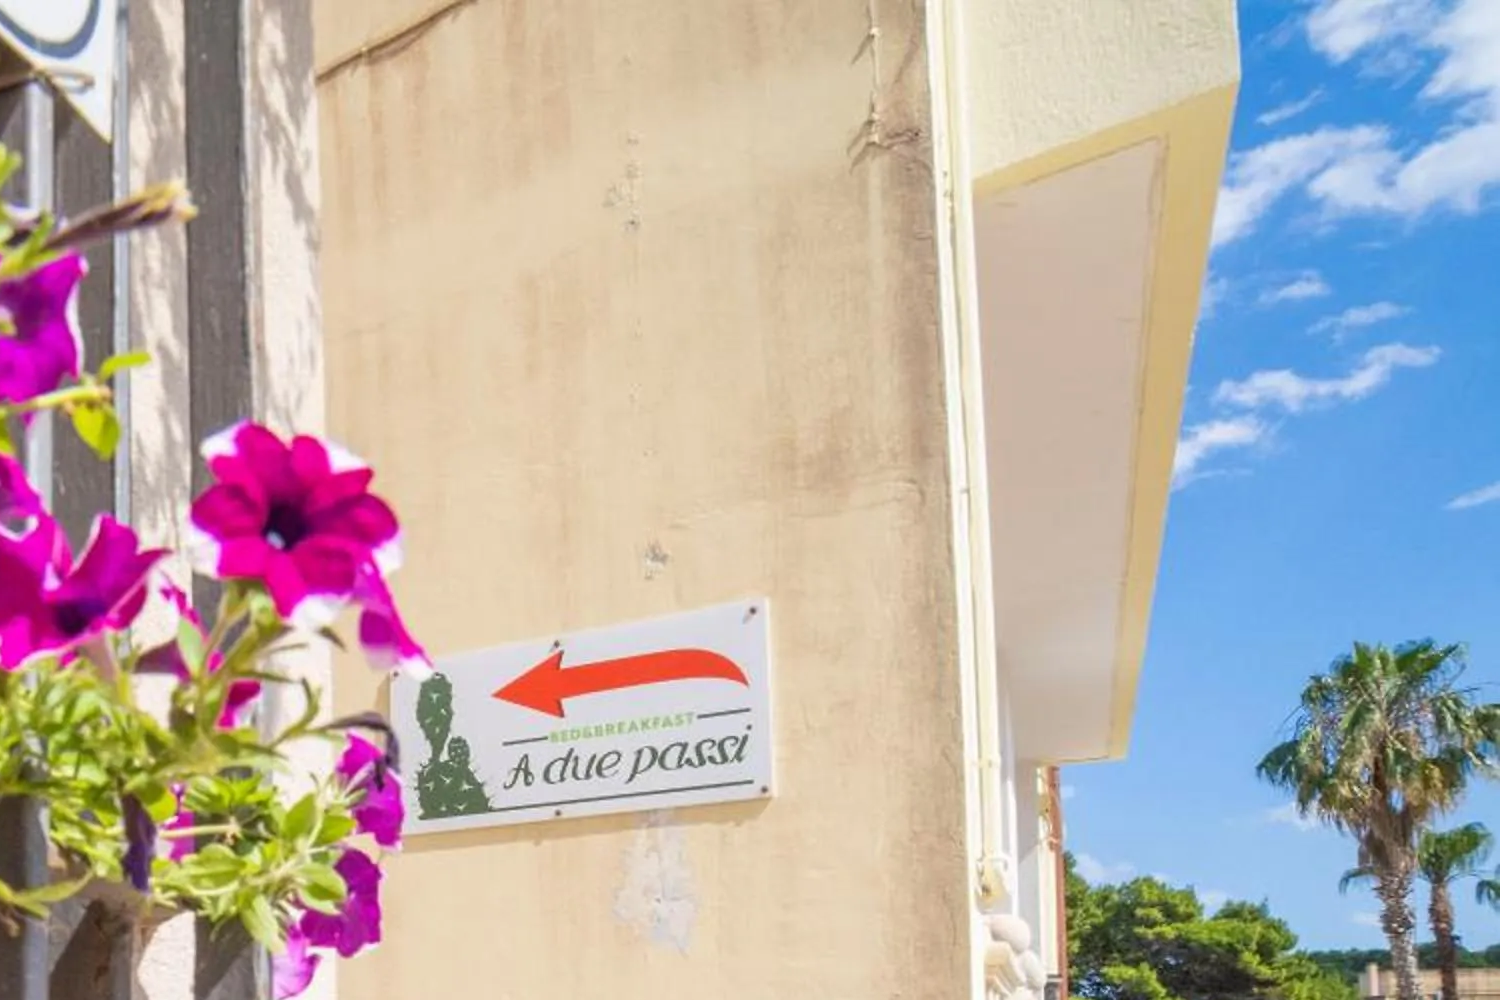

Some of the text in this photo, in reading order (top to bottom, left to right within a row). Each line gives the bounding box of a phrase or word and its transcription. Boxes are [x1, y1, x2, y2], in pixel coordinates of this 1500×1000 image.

[503, 724, 753, 790] A due passi
